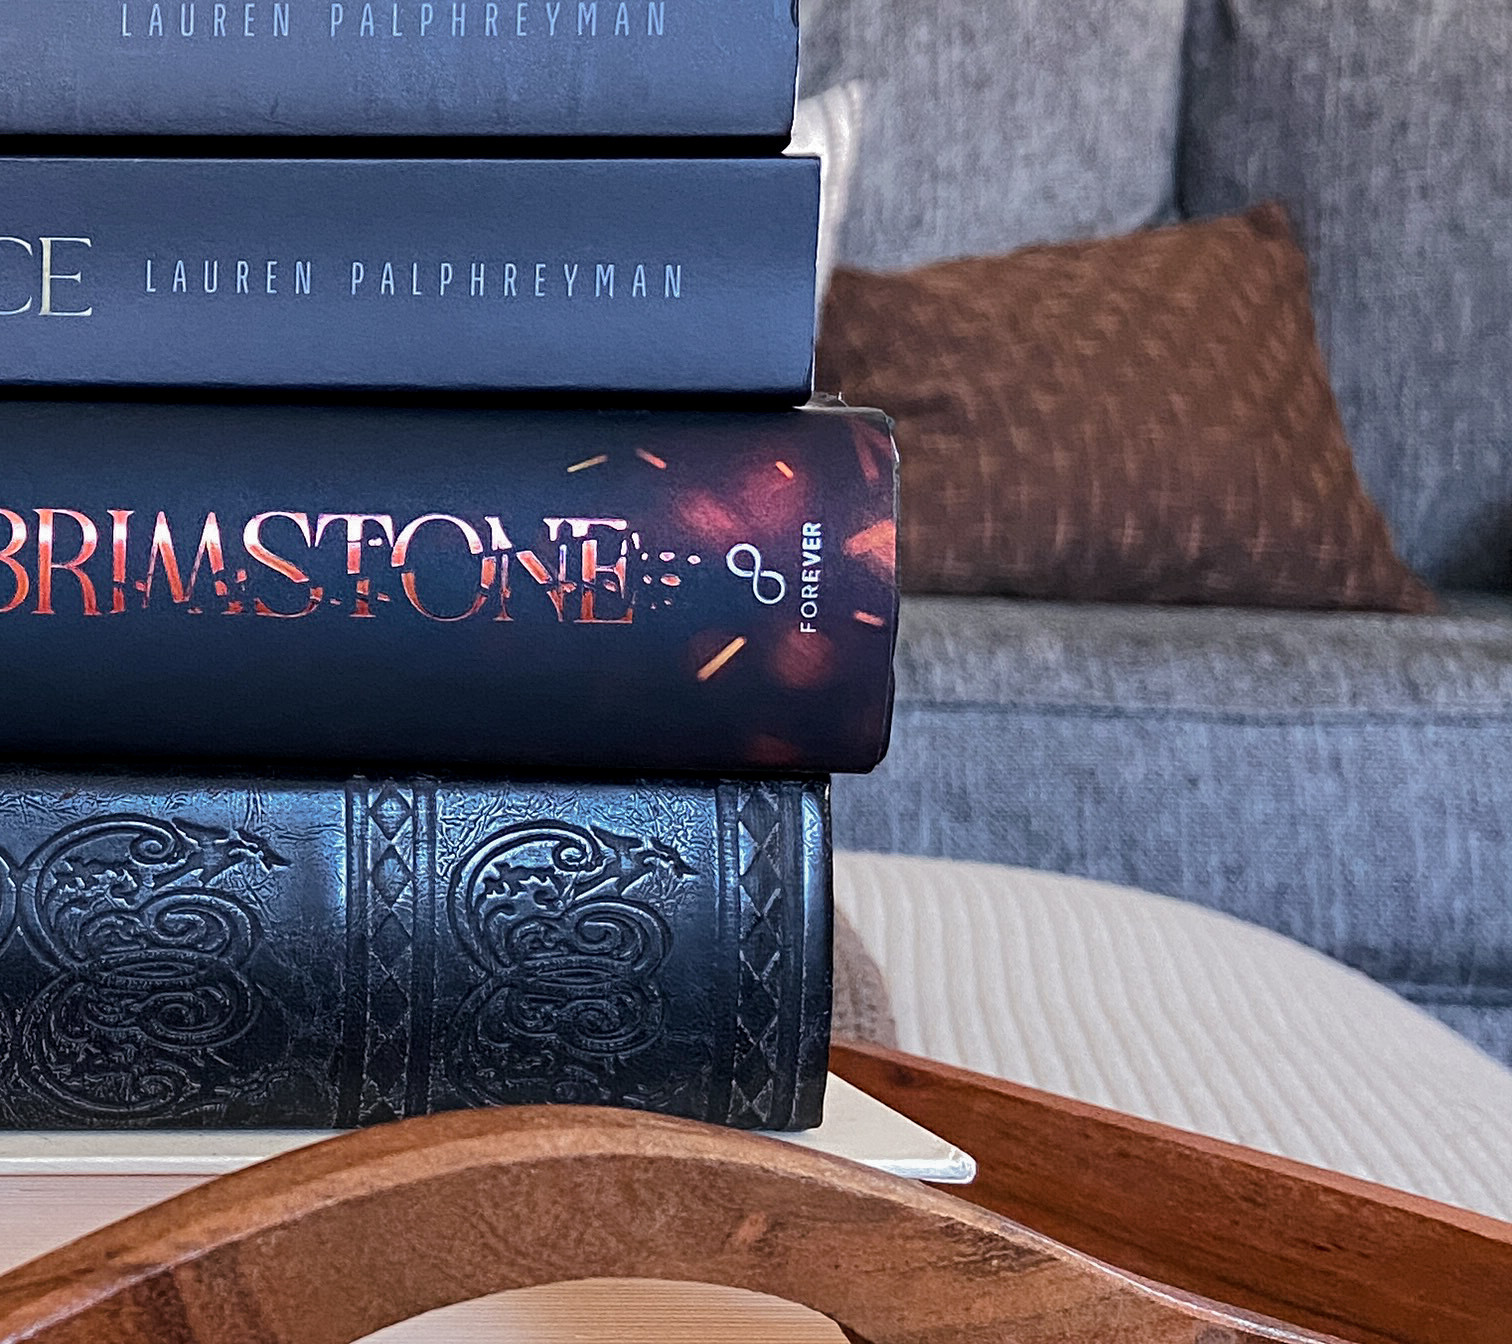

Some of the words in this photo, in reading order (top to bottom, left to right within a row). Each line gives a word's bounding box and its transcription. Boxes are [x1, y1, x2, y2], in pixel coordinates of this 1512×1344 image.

[120, 2, 291, 38] LAUREN
[330, 1, 666, 38] PALPHREYMAN
[145, 258, 313, 296] LAUREN
[349, 261, 683, 299] PALPHREYMAN
[799, 521, 822, 634] FOREVER
